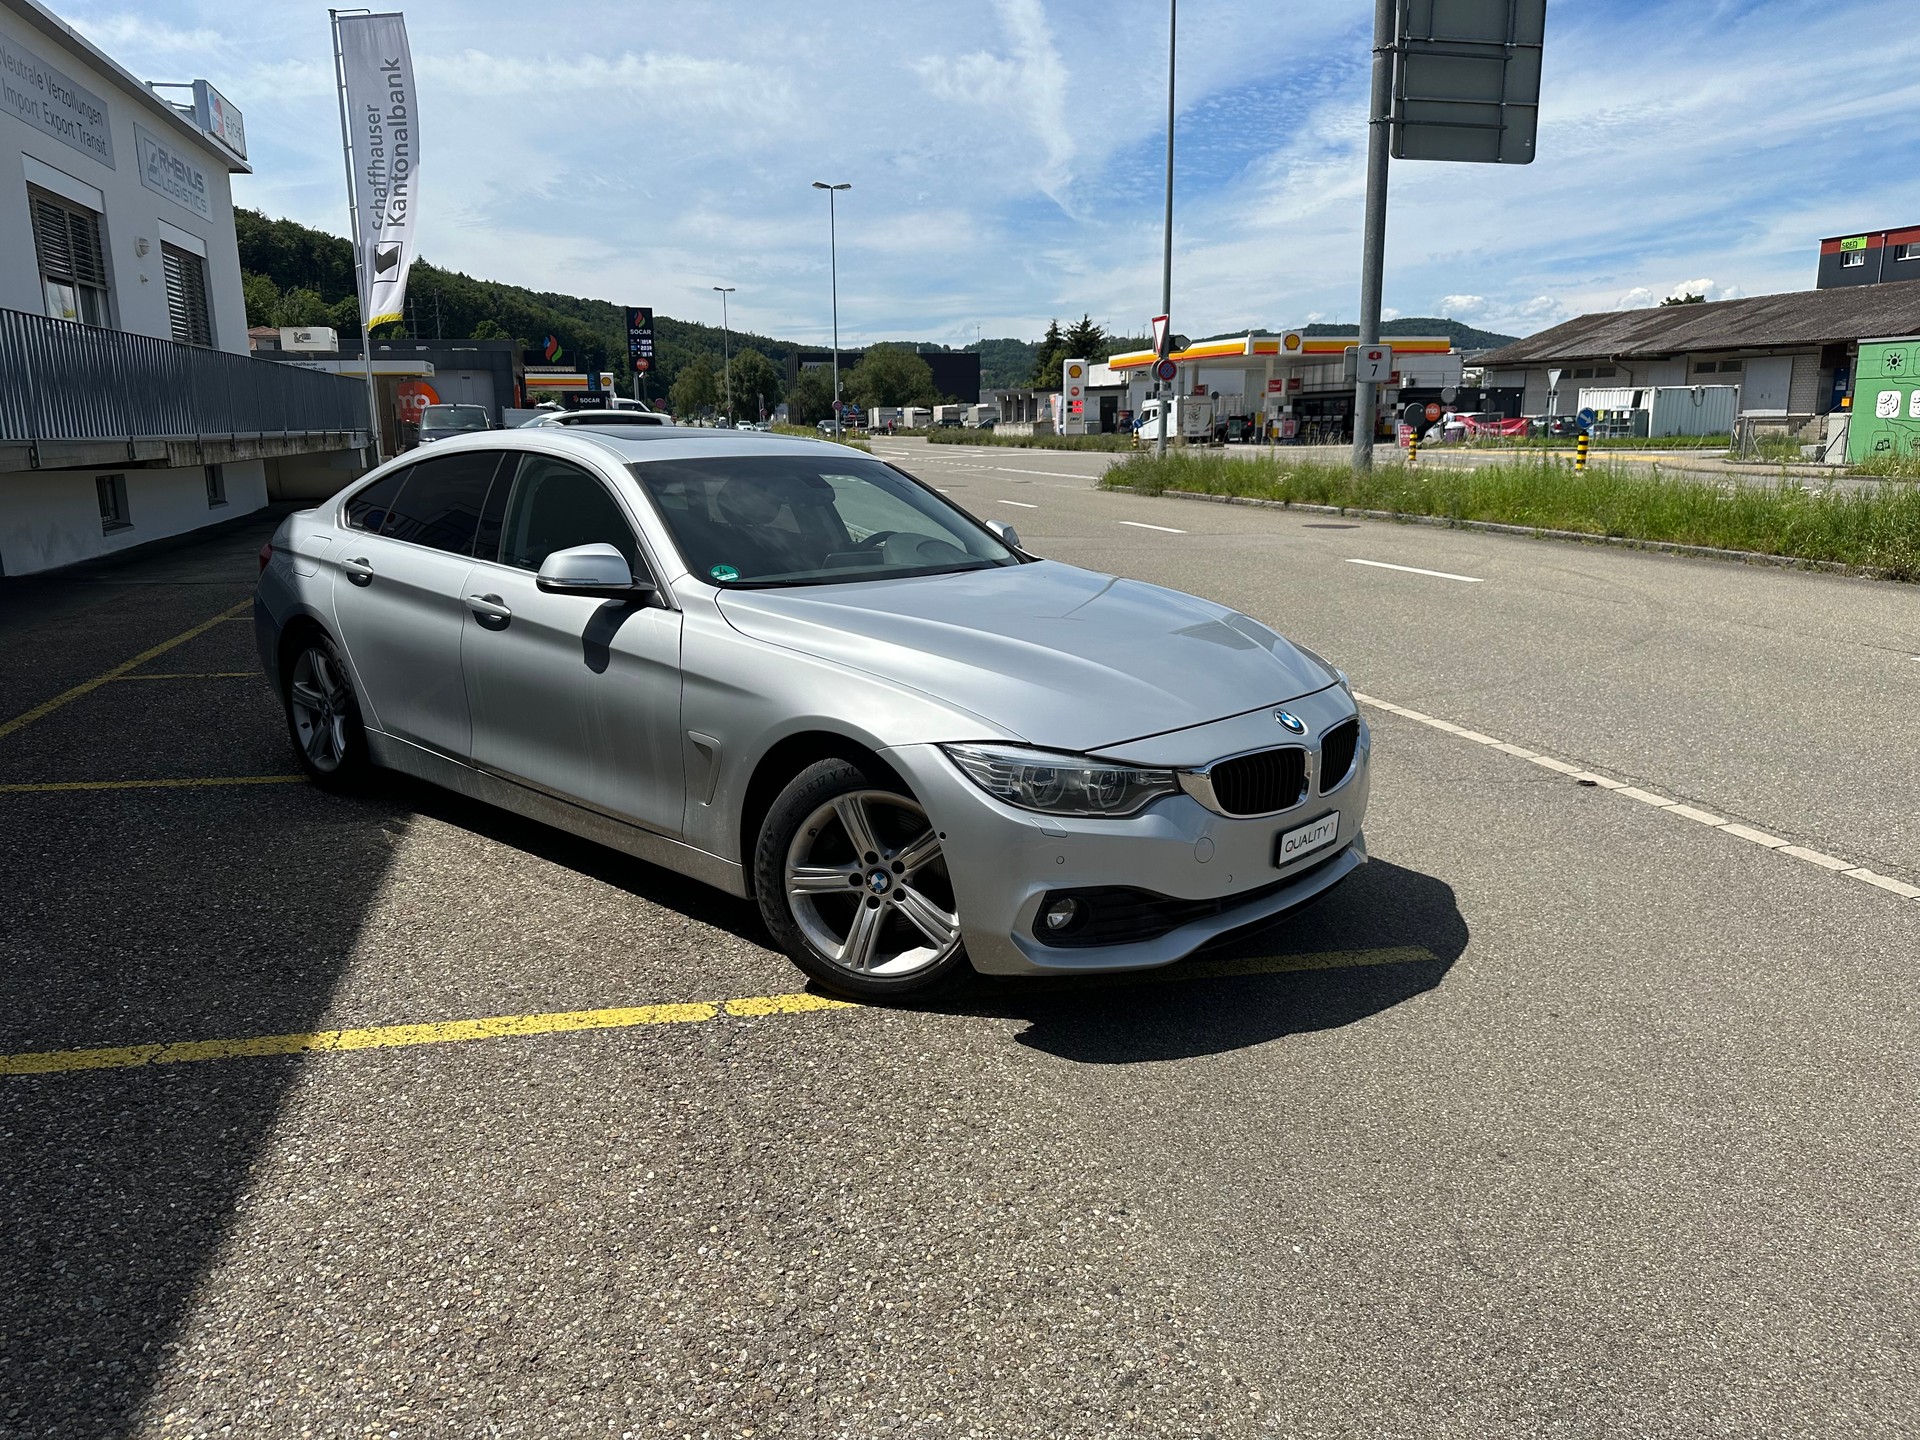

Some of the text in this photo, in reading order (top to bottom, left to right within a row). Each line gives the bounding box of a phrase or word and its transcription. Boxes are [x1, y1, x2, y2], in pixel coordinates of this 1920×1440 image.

[0, 45, 104, 127] Neutrale Verzollungen
[2, 78, 107, 156] Import Export Transit
[380, 57, 409, 228] Kantonalbank
[158, 146, 205, 194] RHENUS
[366, 104, 387, 231] Schaffhauser
[161, 175, 207, 213] LOGISTICS
[1371, 364, 1378, 376] 7
[1372, 351, 1378, 360] 4
[807, 783, 816, 794] R
[815, 775, 826, 788] 17
[829, 770, 838, 782] Y
